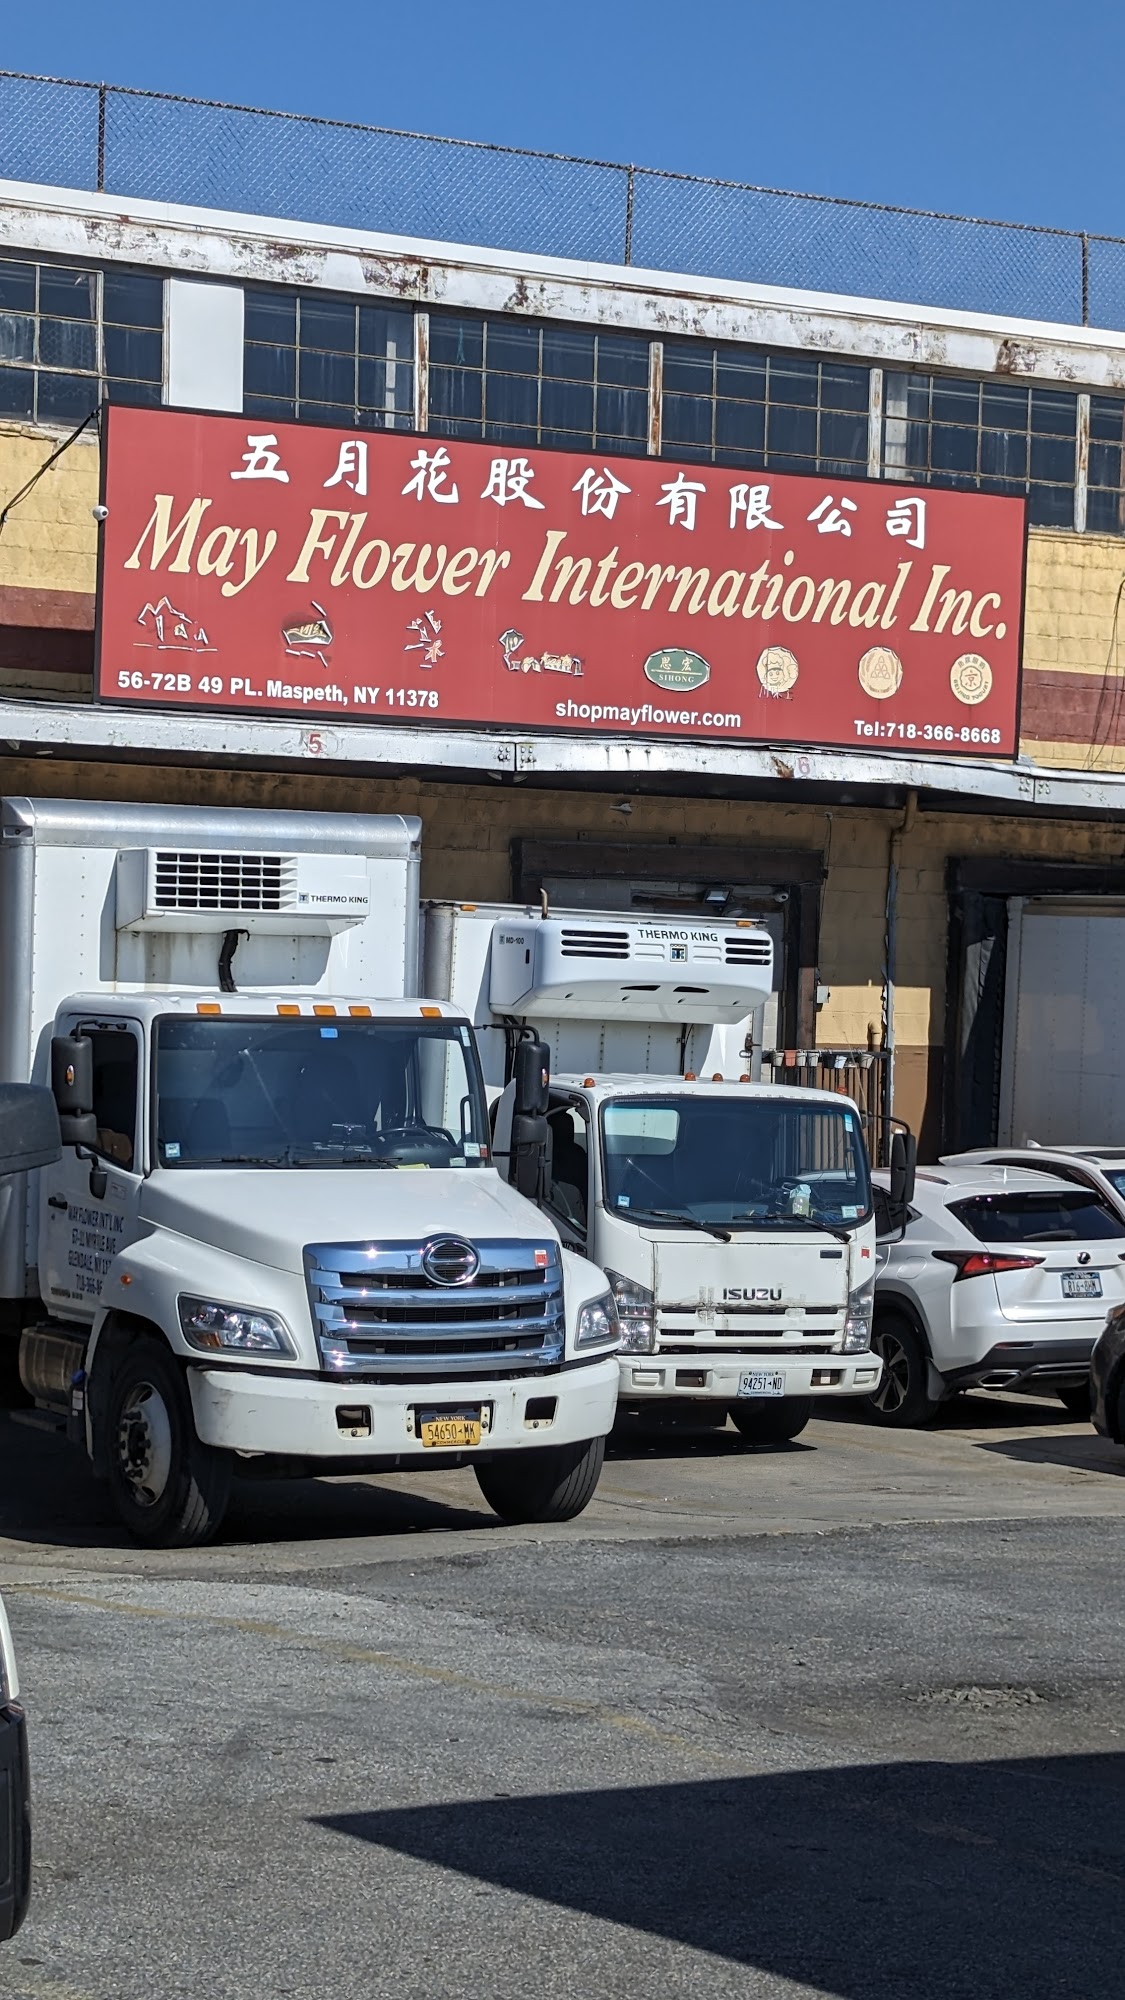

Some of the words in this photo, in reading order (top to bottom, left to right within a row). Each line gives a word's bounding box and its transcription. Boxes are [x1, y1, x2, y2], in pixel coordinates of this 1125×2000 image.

[230, 433, 927, 550] 五月花股份有限公司
[124, 494, 277, 597] May
[286, 508, 510, 598] Flower
[522, 530, 913, 631] International
[910, 564, 1007, 640] Inc.
[117, 671, 191, 692] 56-72B
[198, 676, 223, 694] 49
[230, 677, 263, 697] PL.
[266, 680, 348, 706] Maspeth,
[353, 686, 380, 704] NY
[385, 688, 439, 708] 11378
[659, 674, 694, 683] SIHONG
[555, 700, 742, 729] shopmayflower.com
[854, 720, 1001, 744] Tel:718-366-8668
[308, 733, 322, 755] 5
[798, 757, 811, 776] 6
[310, 895, 347, 903] THERMO
[348, 896, 369, 904] KING
[638, 929, 688, 941] THERMO
[691, 931, 718, 942] KING
[723, 1288, 782, 1301] ISUZU
